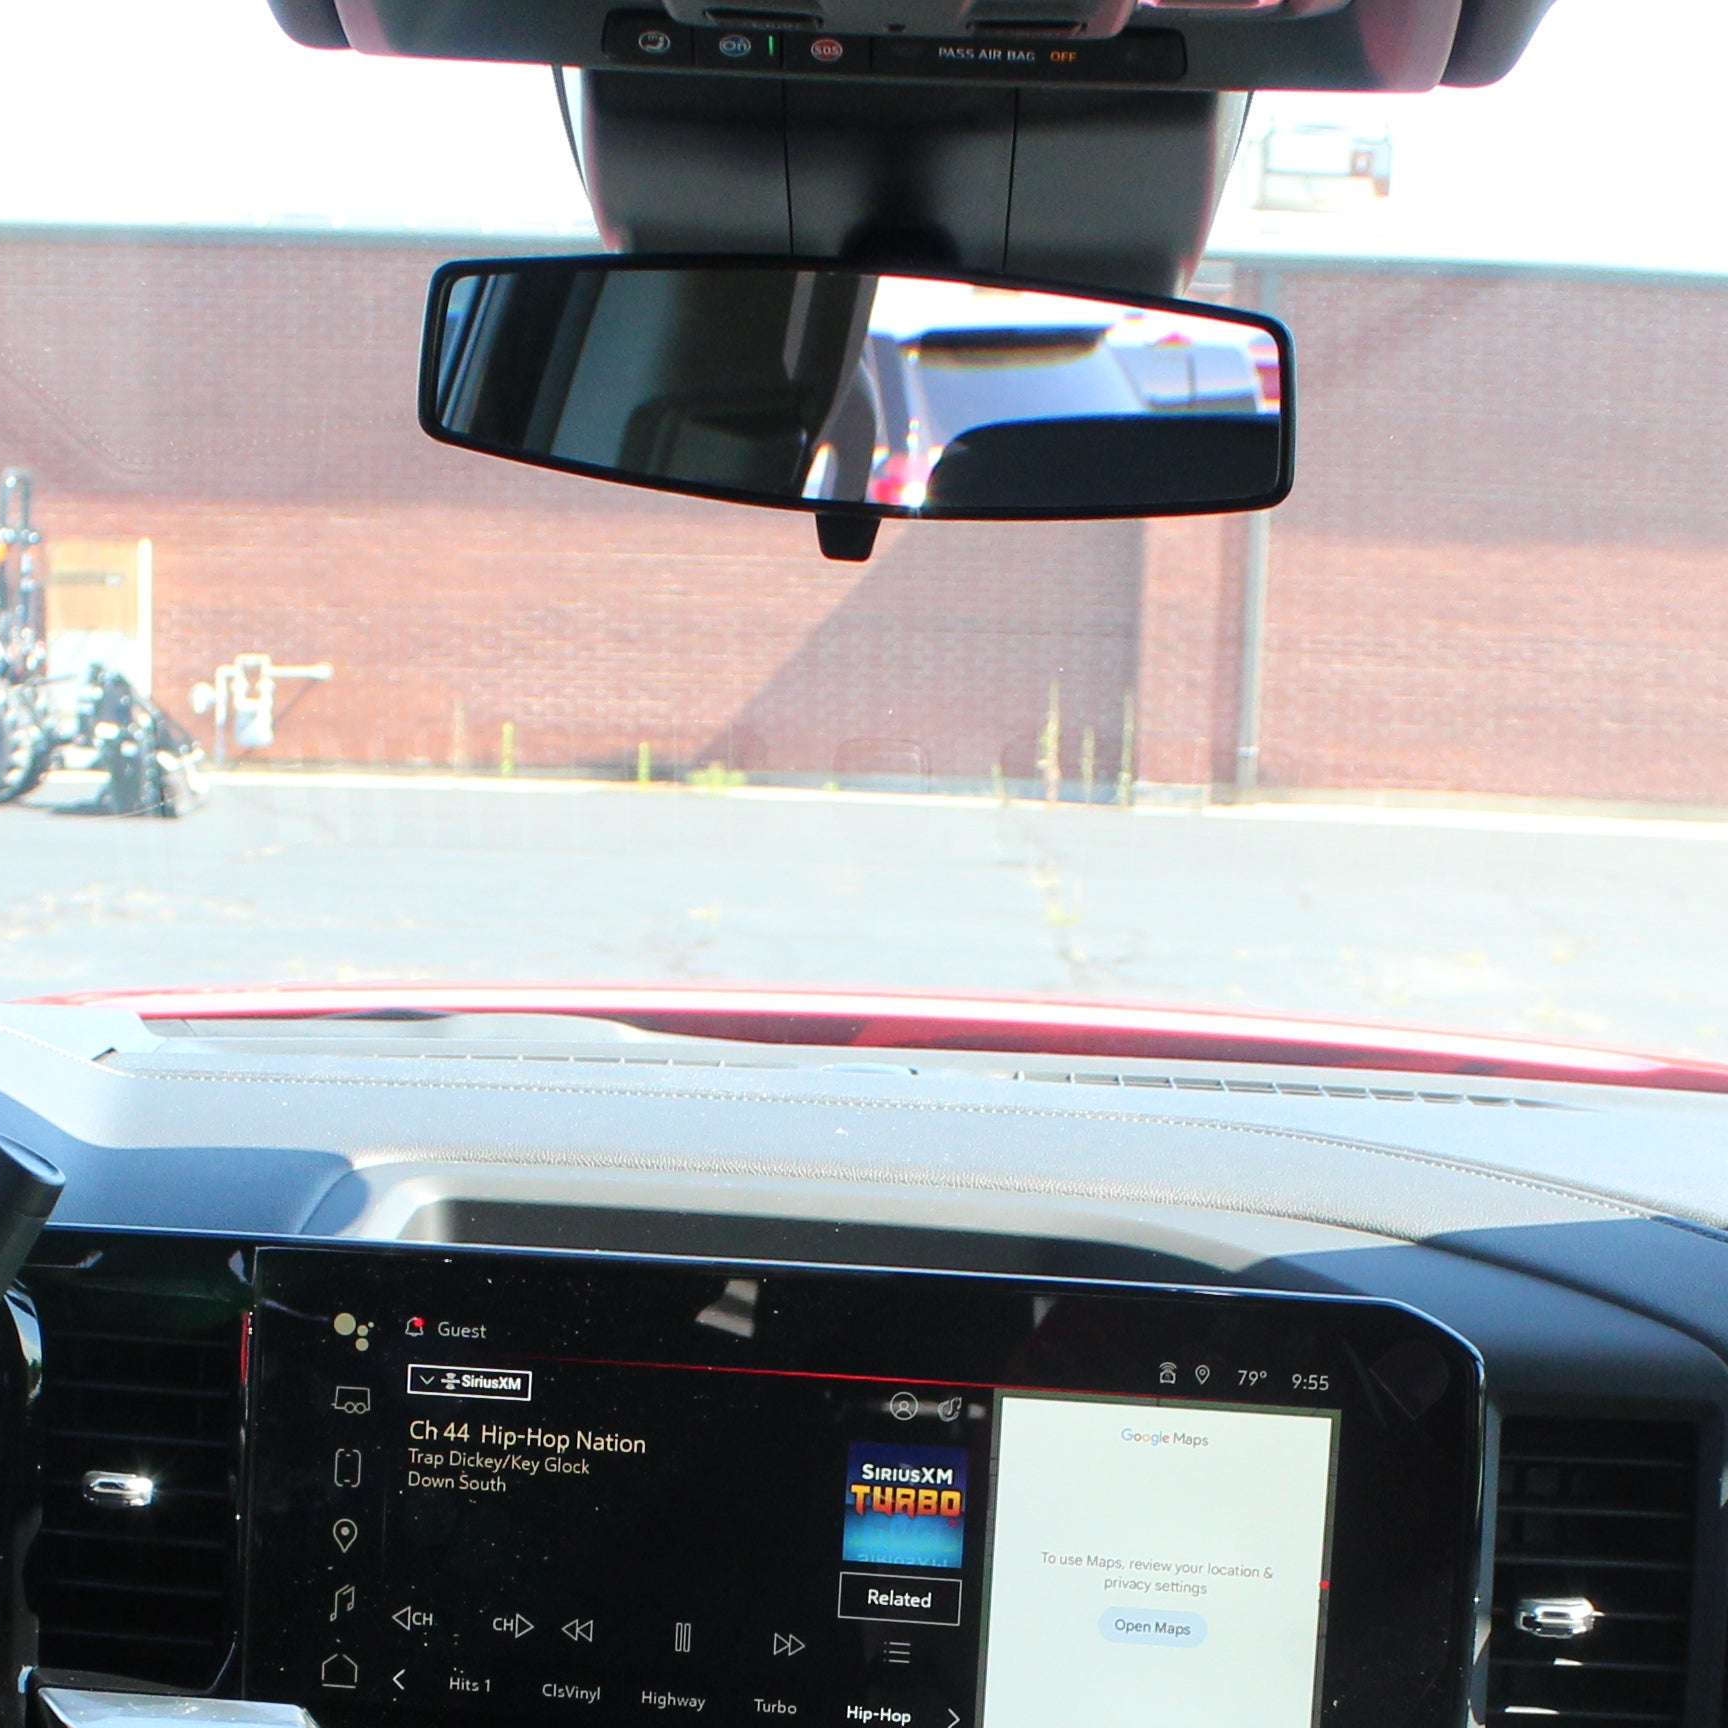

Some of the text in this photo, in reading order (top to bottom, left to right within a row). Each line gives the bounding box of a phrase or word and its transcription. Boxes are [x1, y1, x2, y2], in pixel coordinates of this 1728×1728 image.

[939, 46, 1076, 63] PASS AIR BAG OFF
[438, 1322, 486, 1339] Guest
[462, 1374, 521, 1391] SiriusXM
[1291, 1374, 1329, 1391] 9:55
[409, 1420, 646, 1453] Ch 44 Hip-Hop Nation
[1121, 1428, 1209, 1450] Google Maps
[409, 1448, 590, 1475] Trap Dickey/Key Glock
[409, 1472, 507, 1493] Down South
[850, 1484, 961, 1518] TURBO
[1041, 1550, 1273, 1579] To use Maps, review your location &
[1104, 1577, 1208, 1597] privacy settings
[867, 1589, 932, 1609] Related
[412, 1611, 433, 1627] CH
[492, 1617, 514, 1632] CH
[1114, 1617, 1191, 1638] Open Maps
[449, 1676, 491, 1693] Hits 1
[542, 1682, 601, 1703] ClsVinyl
[641, 1690, 706, 1712] Highway
[754, 1697, 797, 1715] Turbo
[847, 1705, 911, 1727] Hip-Hop
